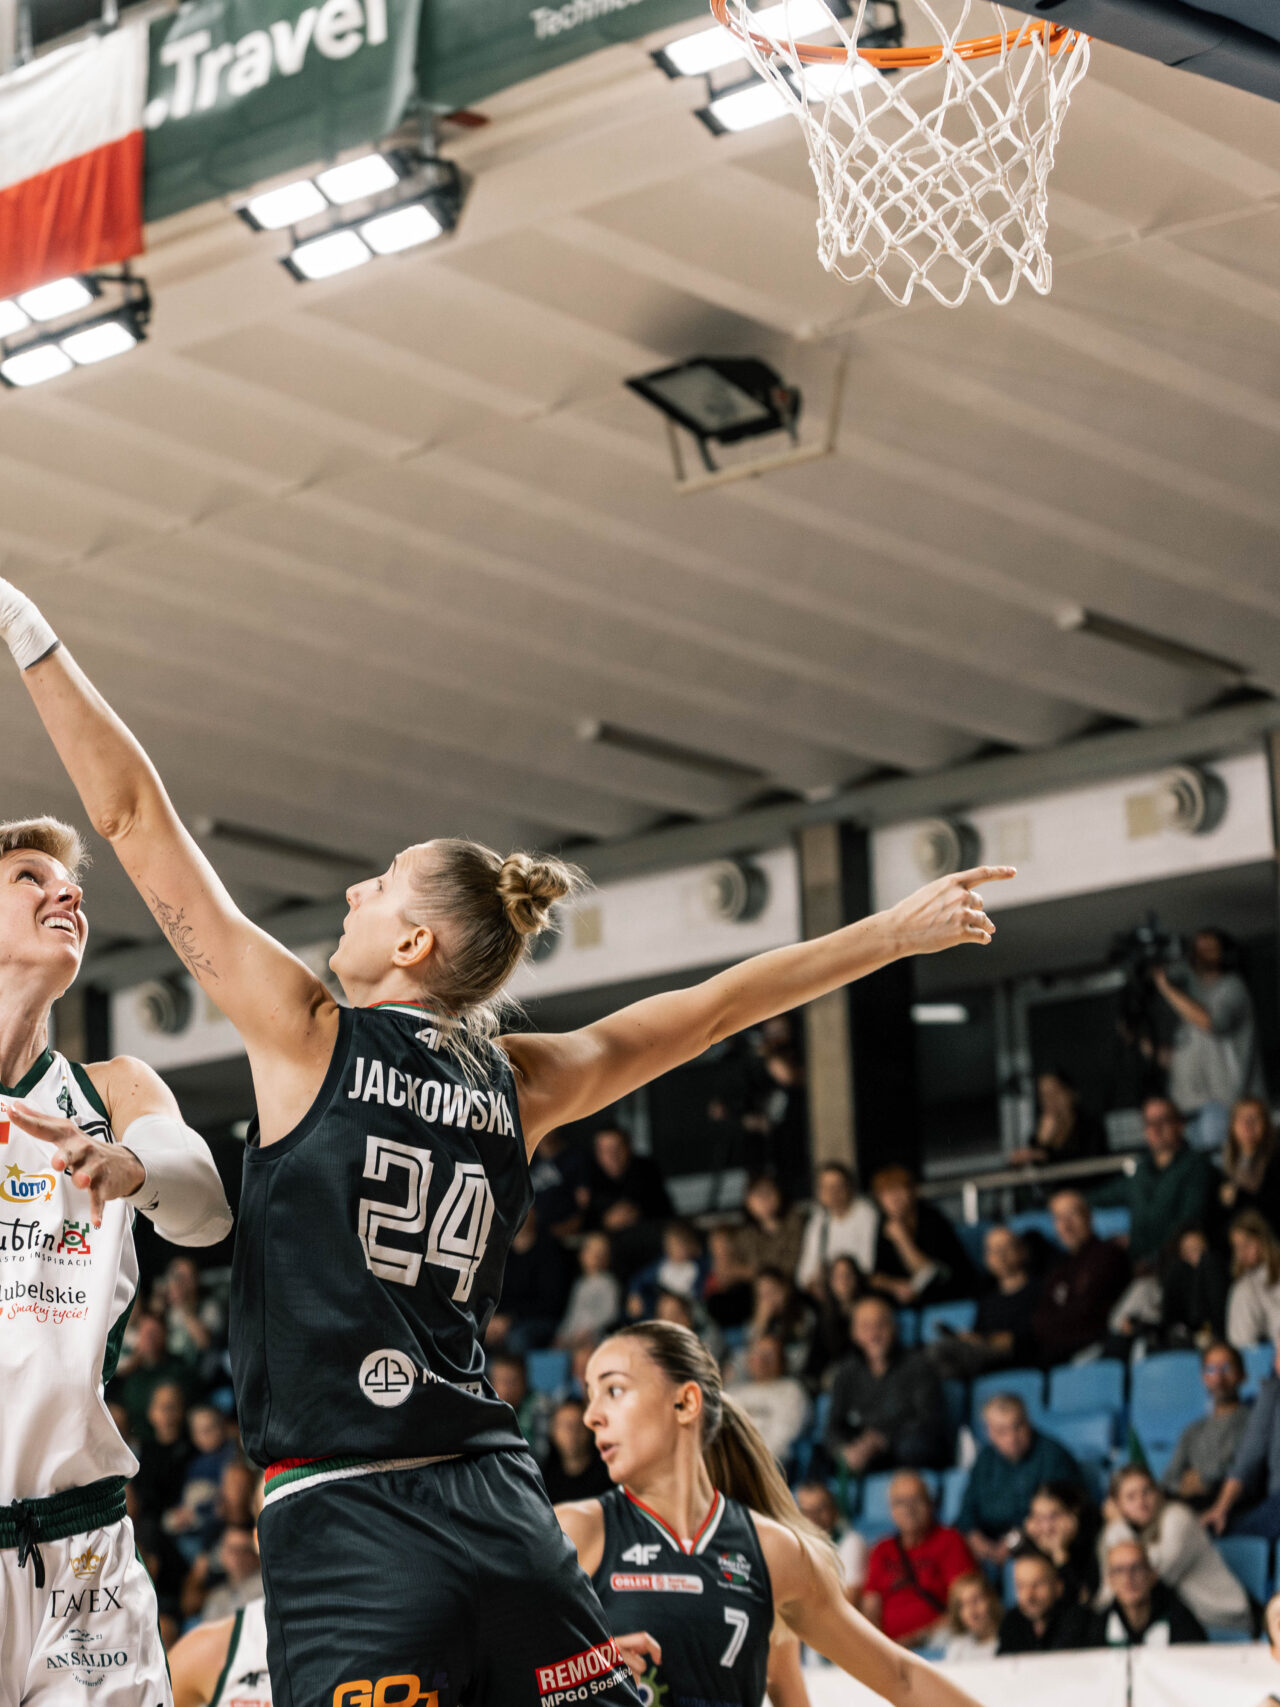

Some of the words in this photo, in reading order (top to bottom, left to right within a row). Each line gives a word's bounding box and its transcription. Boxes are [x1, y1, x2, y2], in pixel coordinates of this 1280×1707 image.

[348, 1057, 516, 1138] JACKOWSKA
[10, 1179, 46, 1197] LOTTO
[358, 1135, 496, 1302] 24
[30, 1251, 92, 1267] INSPIRACJI
[7, 1302, 51, 1323] Smakuj
[52, 1307, 88, 1324] życie!
[720, 1606, 749, 1668] 7
[46, 1651, 128, 1669] ANSALDO
[540, 1641, 624, 1691] REMONDI
